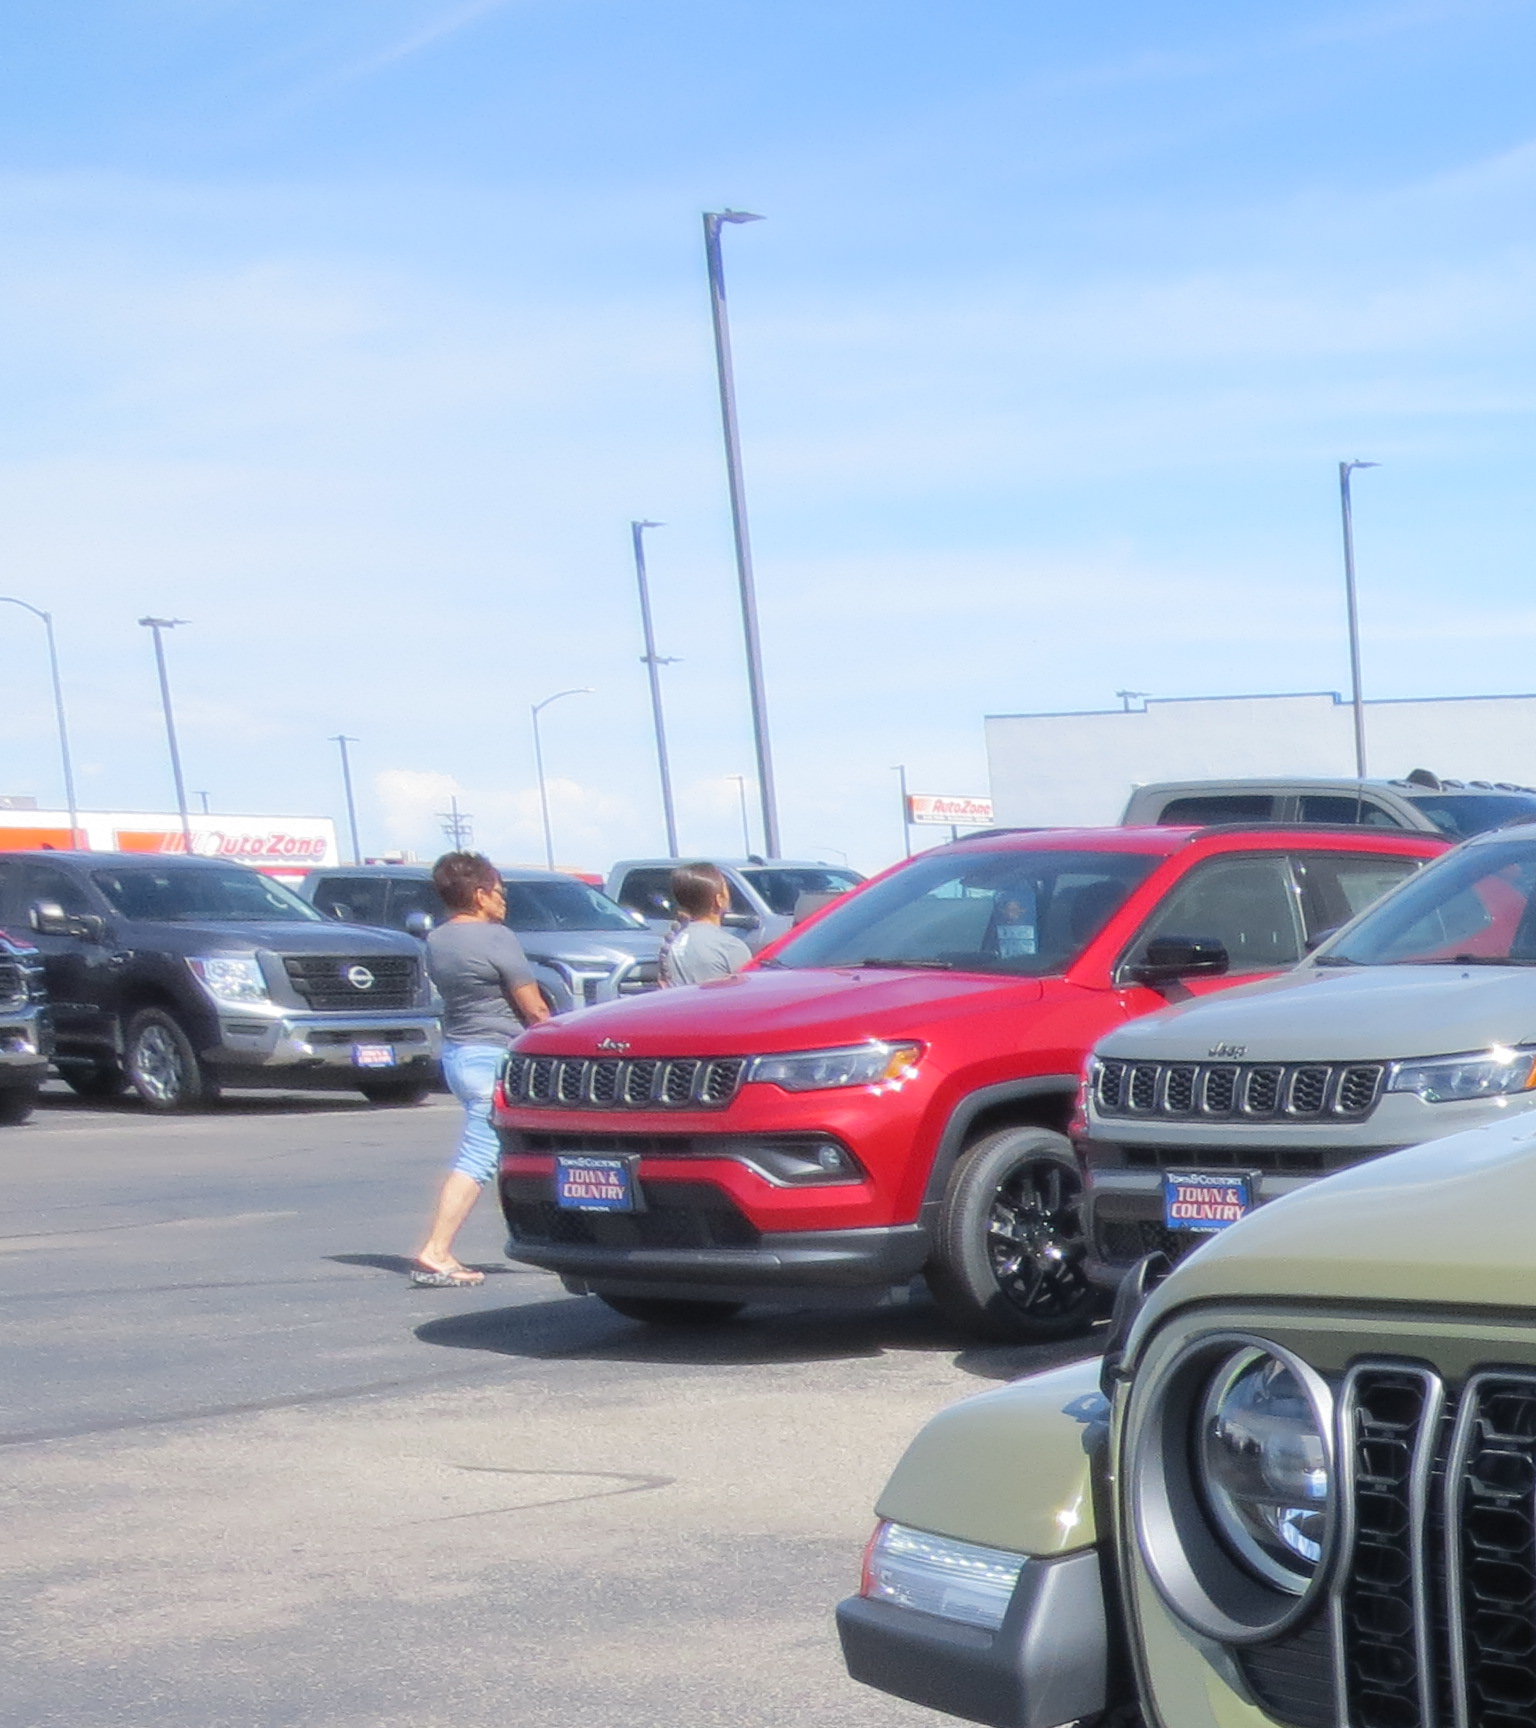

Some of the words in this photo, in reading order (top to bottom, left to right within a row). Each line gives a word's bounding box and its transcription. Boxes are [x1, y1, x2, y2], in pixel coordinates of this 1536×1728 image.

[568, 1168, 607, 1184] TOWN
[608, 1170, 619, 1185] &
[563, 1184, 625, 1200] COUNTRY
[1177, 1186, 1224, 1203] TOWN
[1226, 1188, 1239, 1204] &
[1171, 1203, 1246, 1221] COUNTRY
